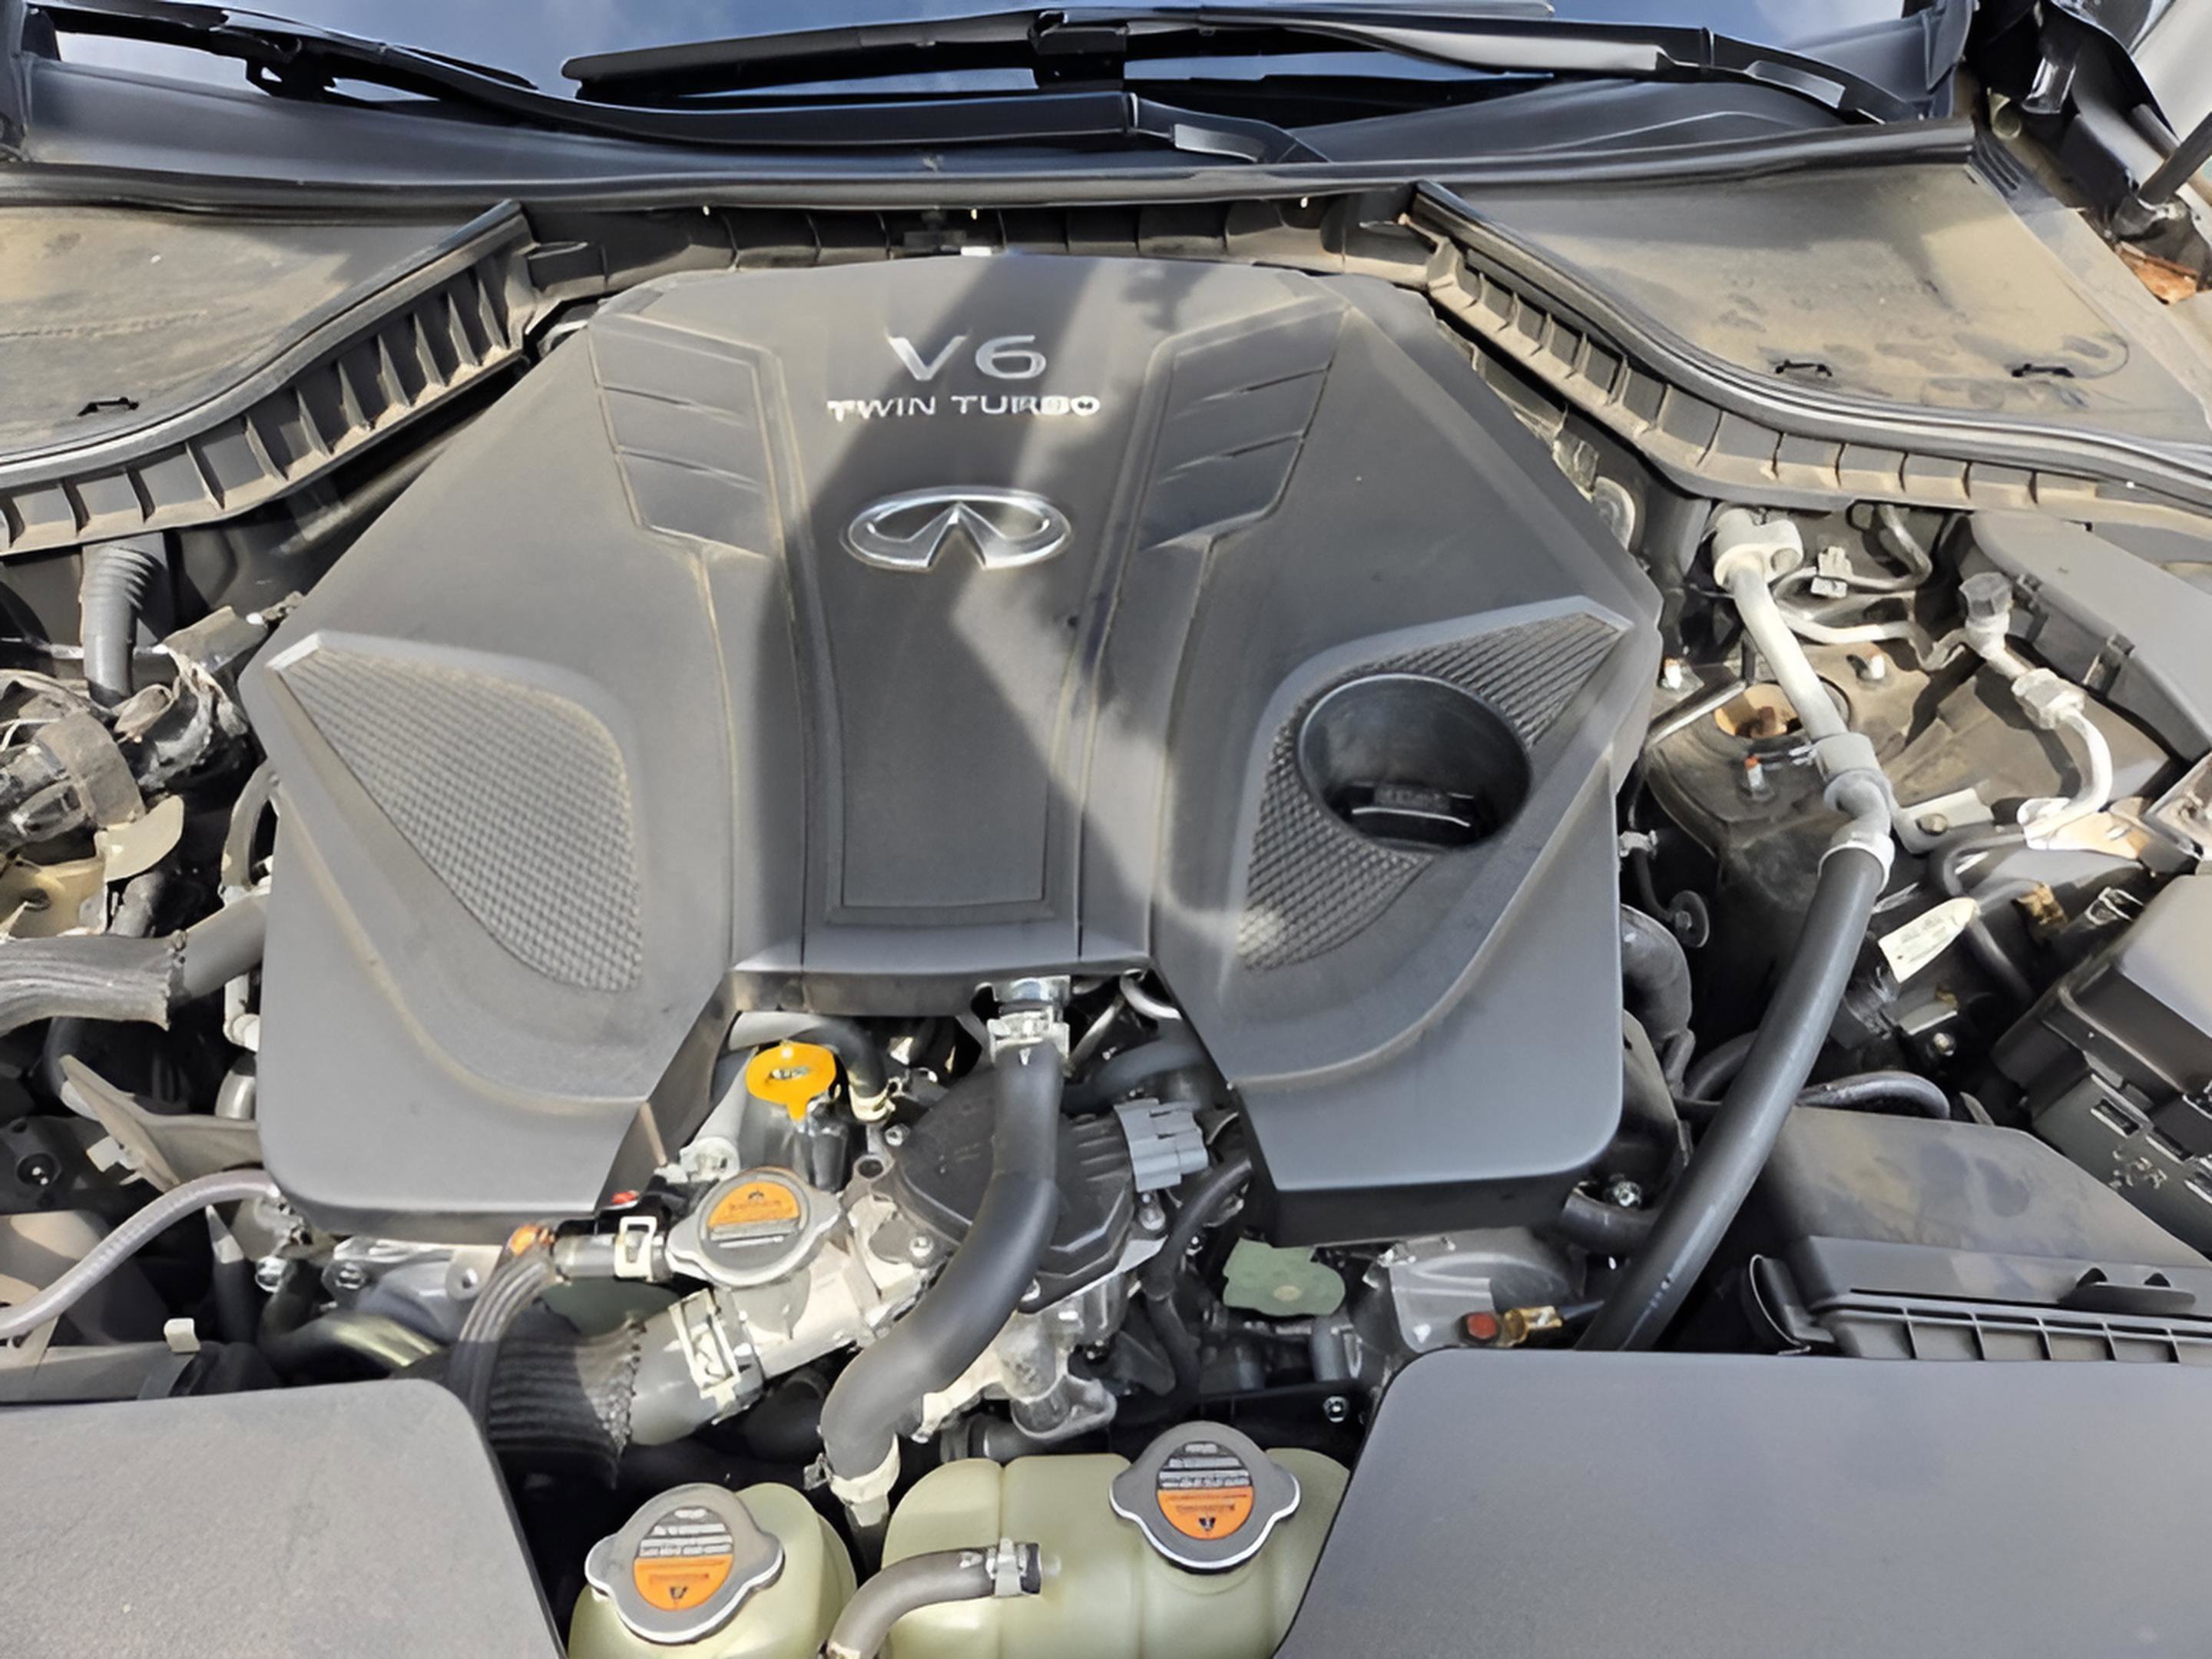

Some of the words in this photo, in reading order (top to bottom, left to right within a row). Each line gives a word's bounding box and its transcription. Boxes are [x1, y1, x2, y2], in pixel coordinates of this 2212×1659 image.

[886, 333, 1047, 382] V6
[826, 396, 936, 422] TWIN
[951, 394, 1101, 416] TURBO
